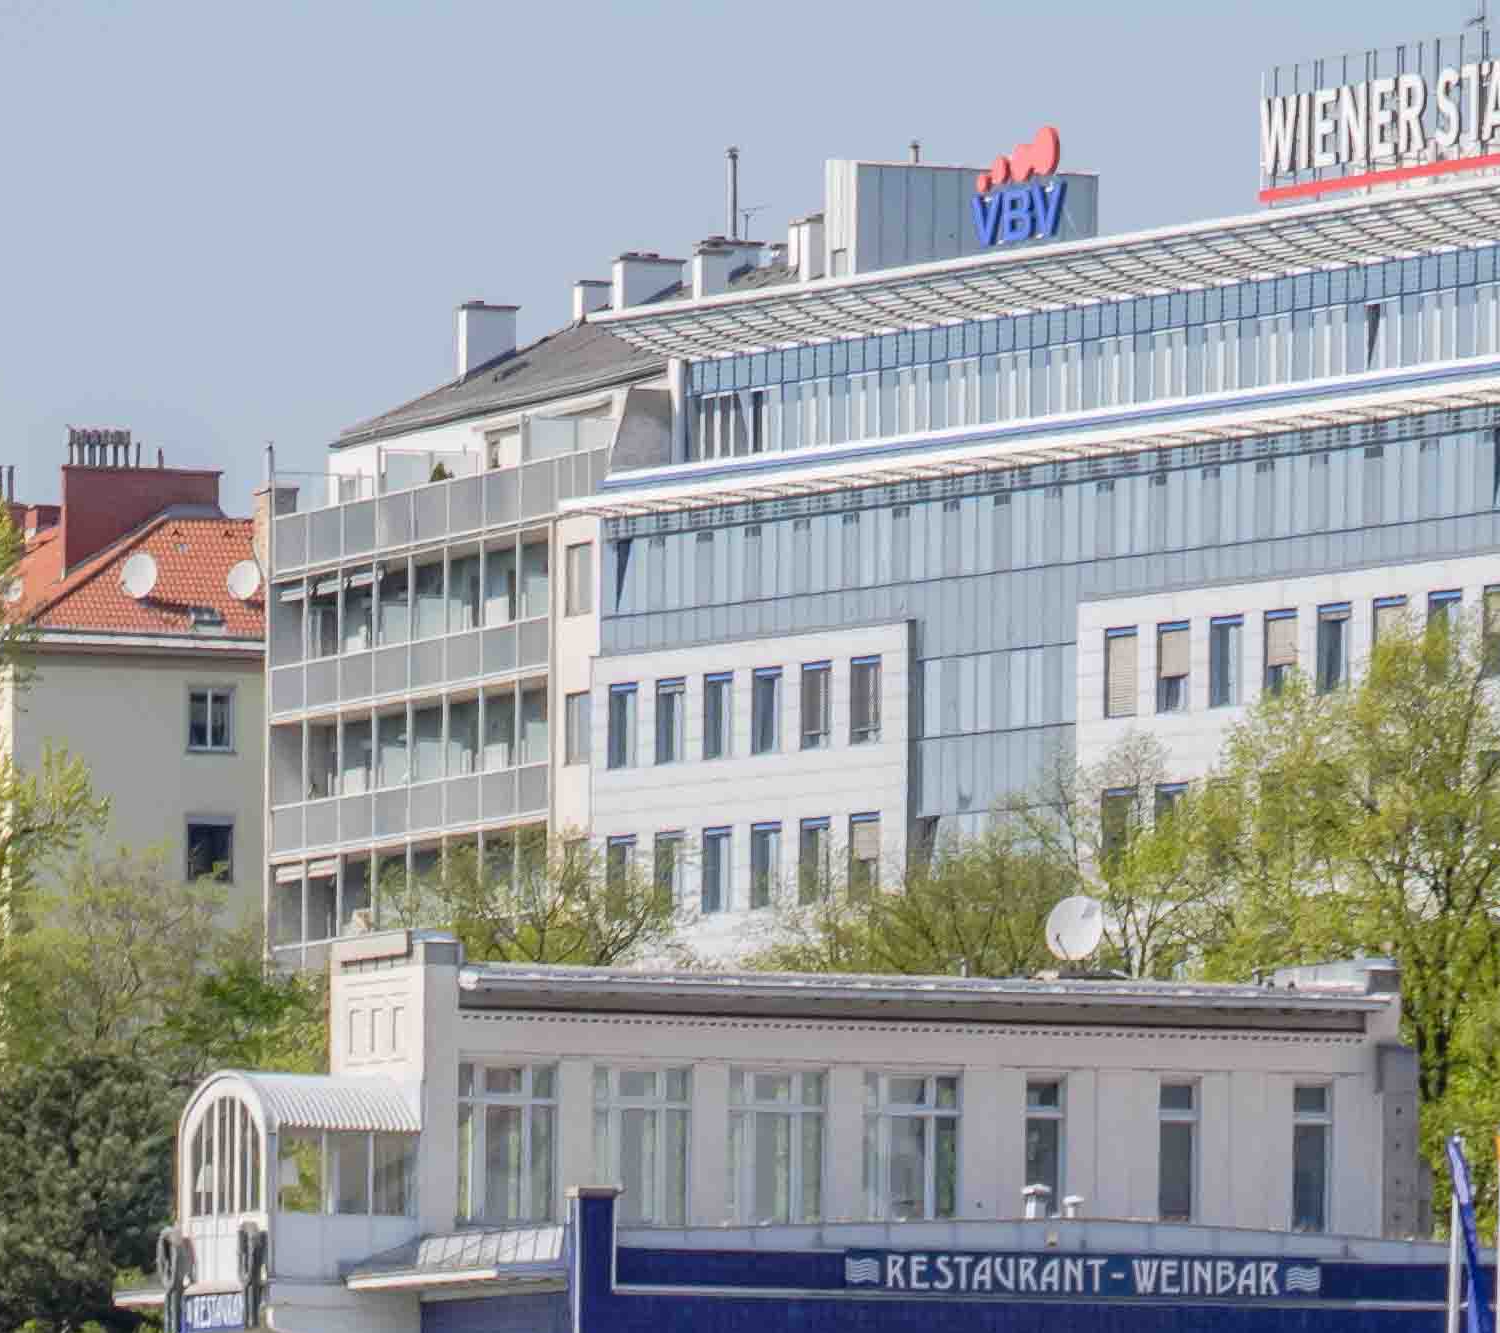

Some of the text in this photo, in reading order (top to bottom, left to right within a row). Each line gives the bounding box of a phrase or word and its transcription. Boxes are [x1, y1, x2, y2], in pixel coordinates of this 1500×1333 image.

[1261, 73, 1428, 177] WIENER
[970, 179, 1068, 248] VBV
[884, 1254, 1108, 1292] RESTAURANT
[1131, 1258, 1280, 1296] WEINBAR
